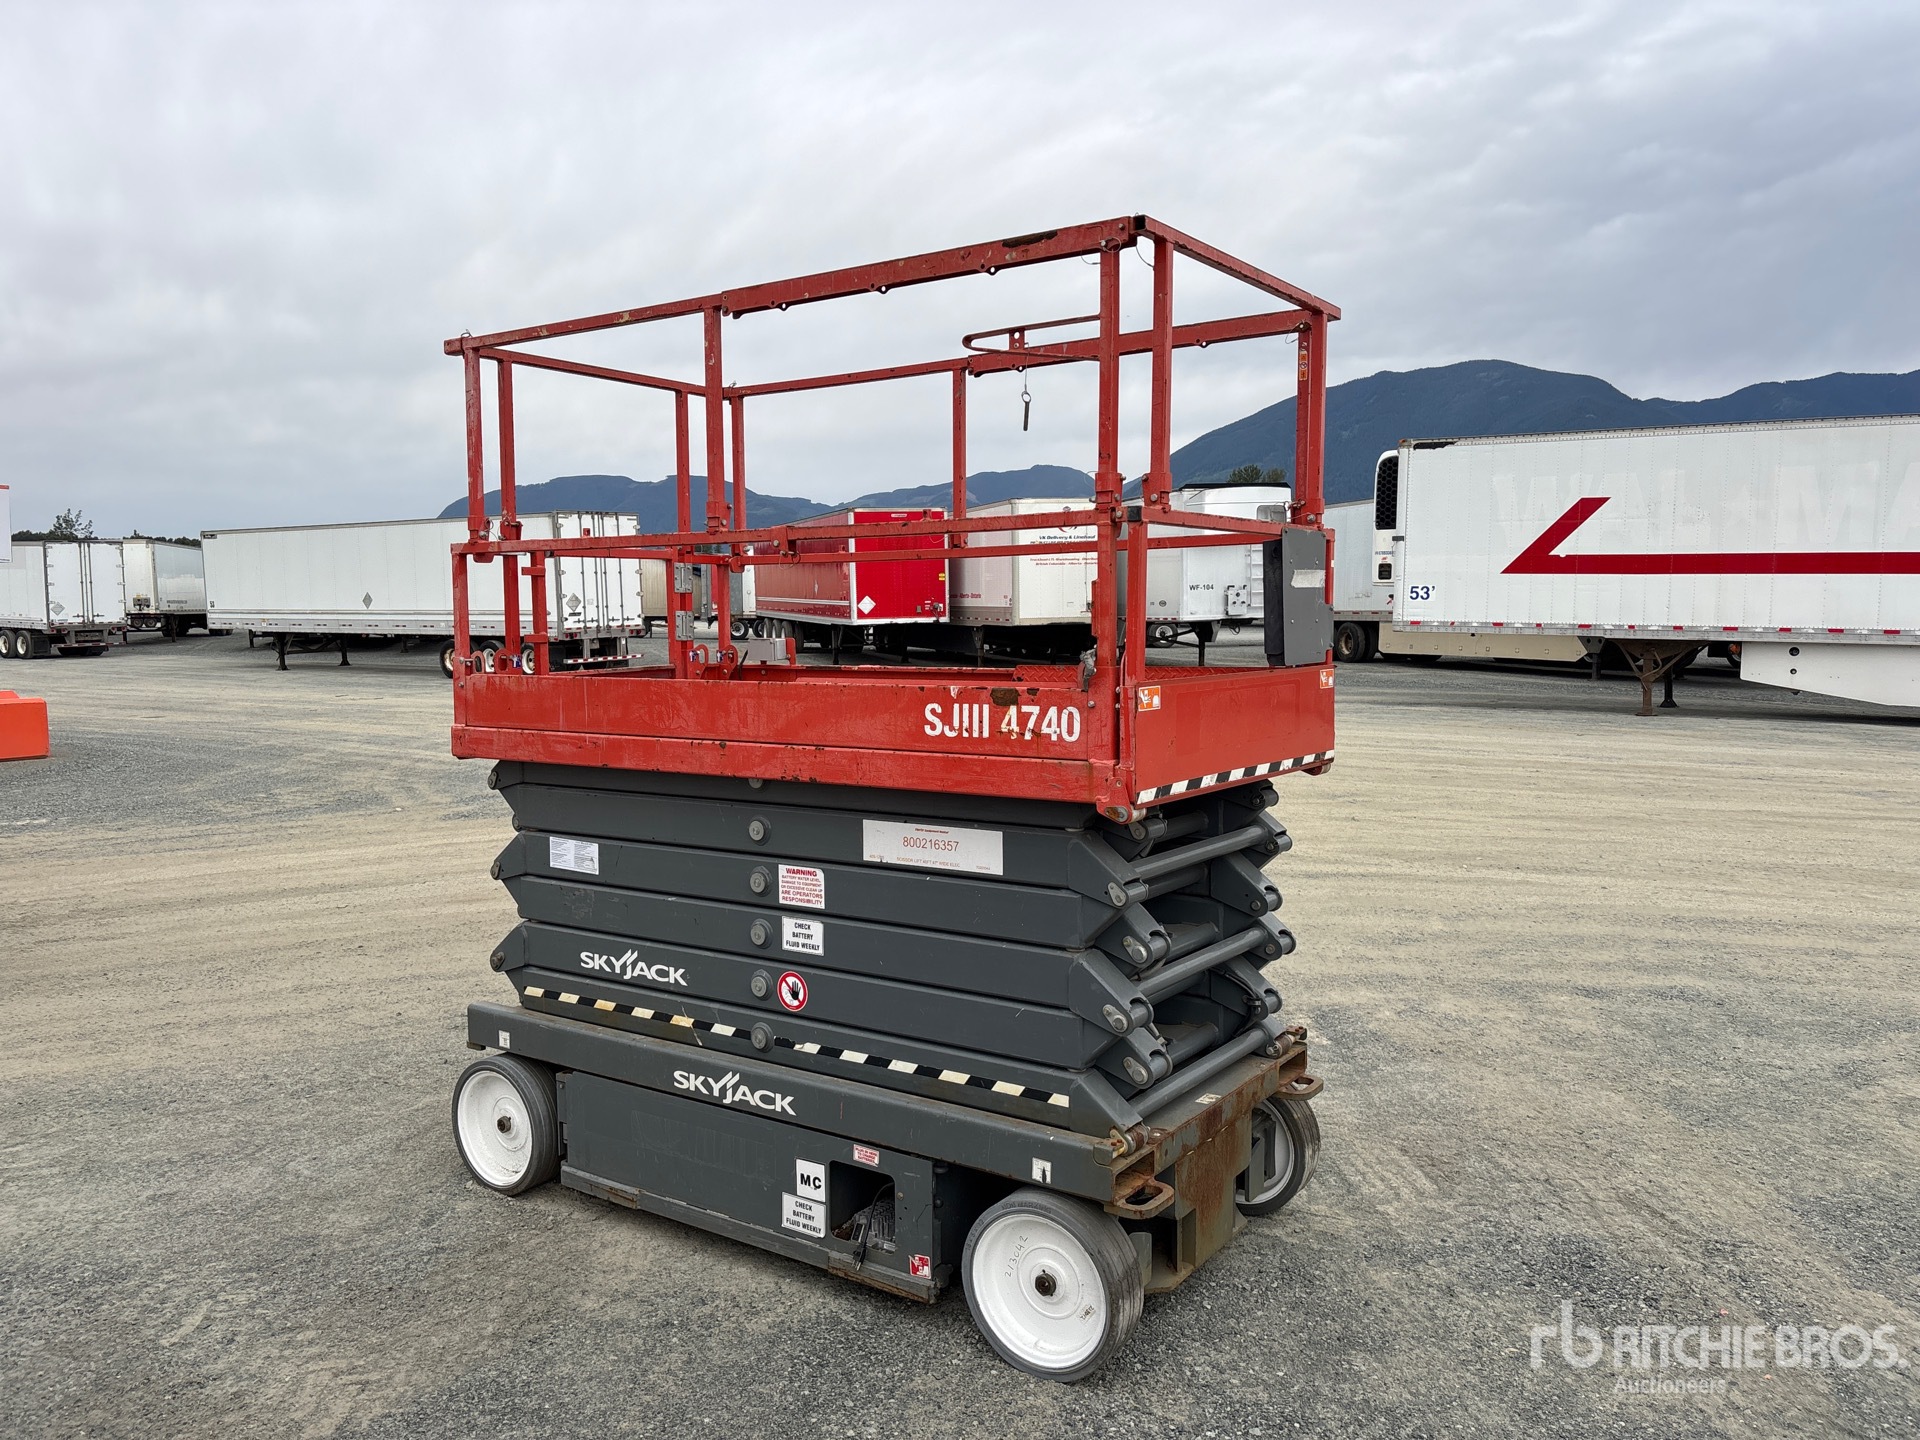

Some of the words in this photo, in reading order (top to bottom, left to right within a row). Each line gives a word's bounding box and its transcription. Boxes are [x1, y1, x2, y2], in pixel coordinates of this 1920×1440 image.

[924, 703, 990, 738] SJIII
[1000, 705, 1081, 742] 4740
[903, 836, 959, 852] 800216357
[786, 868, 817, 877] WARNING
[782, 896, 822, 905] RESPONSIBILITY
[792, 891, 822, 899] OPERATORS
[794, 922, 811, 930] CHECK
[792, 932, 813, 940] BATTERY
[801, 942, 820, 951] WEEKLY
[580, 948, 688, 986] SKYJACK
[673, 1071, 797, 1116] SKYJACK
[800, 1173, 822, 1189] MC
[795, 1201, 812, 1212] CHECK
[793, 1210, 815, 1222] BATTERY
[786, 1218, 800, 1227] FLUID
[802, 1222, 822, 1233] WEEKLY
